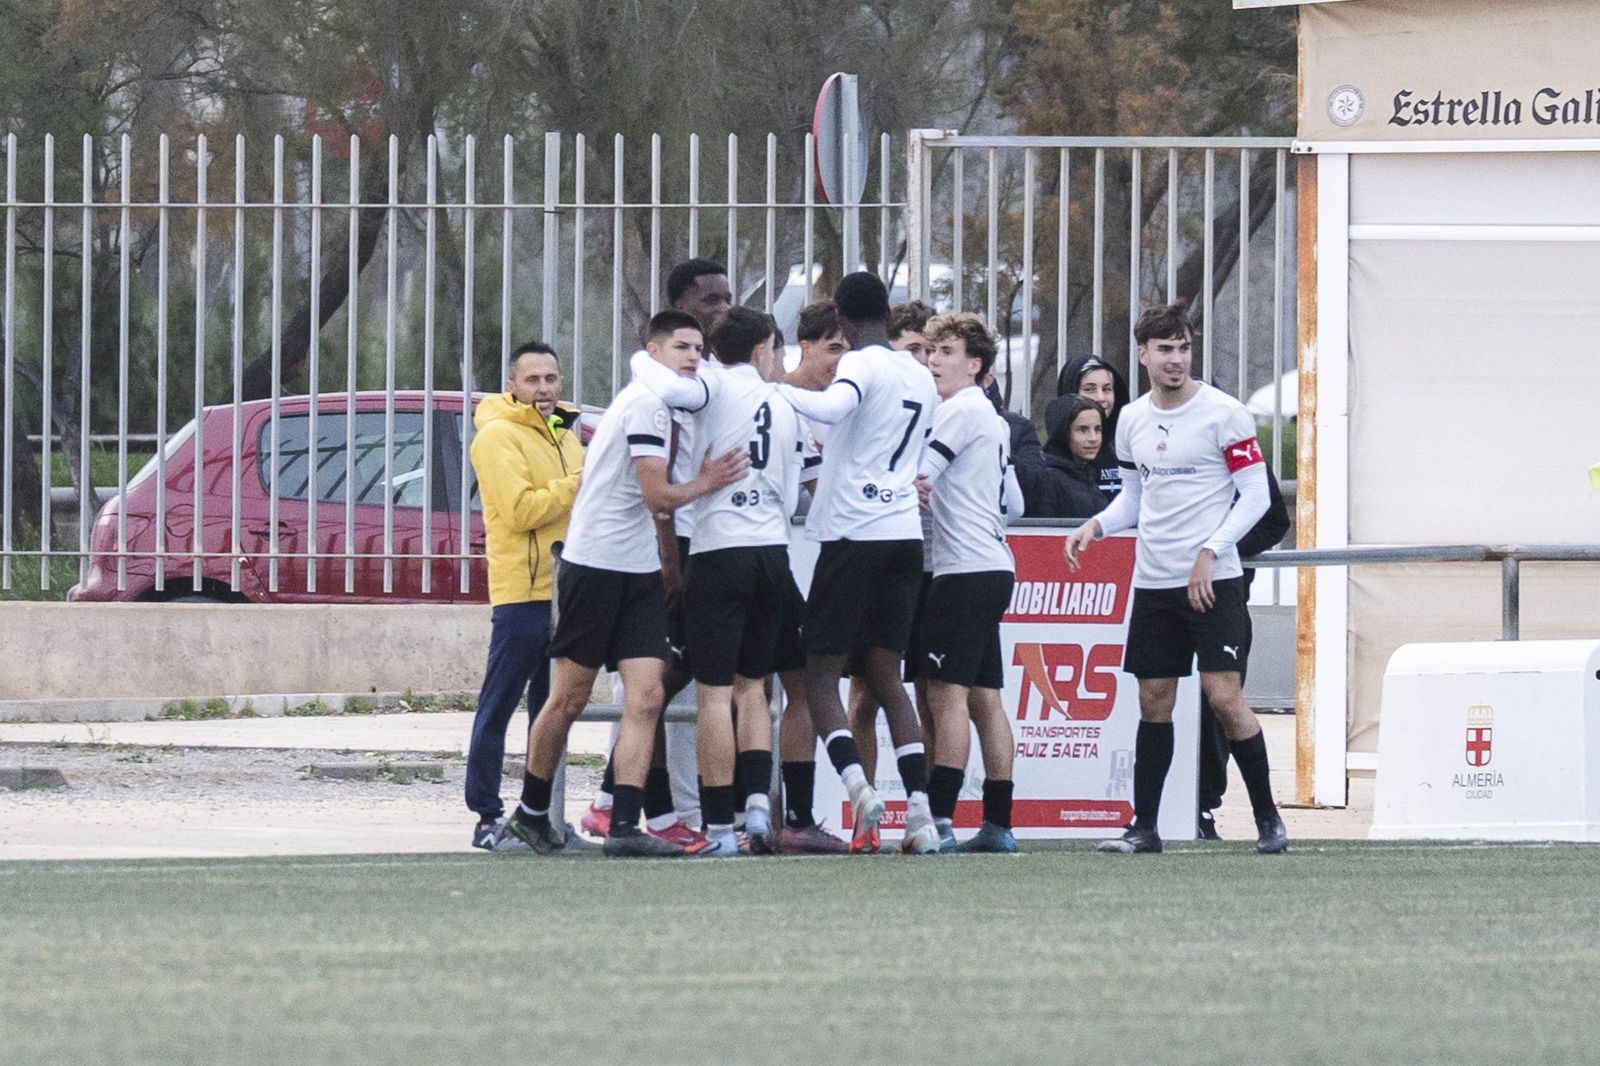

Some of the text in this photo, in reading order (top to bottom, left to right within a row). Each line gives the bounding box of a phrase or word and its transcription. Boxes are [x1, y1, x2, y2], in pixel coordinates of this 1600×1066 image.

[1388, 89, 1522, 127] Estrella
[749, 401, 771, 470] 3
[889, 399, 922, 472] 7
[1020, 726, 1101, 739] TRANSPORTES
[1015, 742, 1098, 759] RUIZ SAETA
[1452, 770, 1504, 788] ALMERÍA
